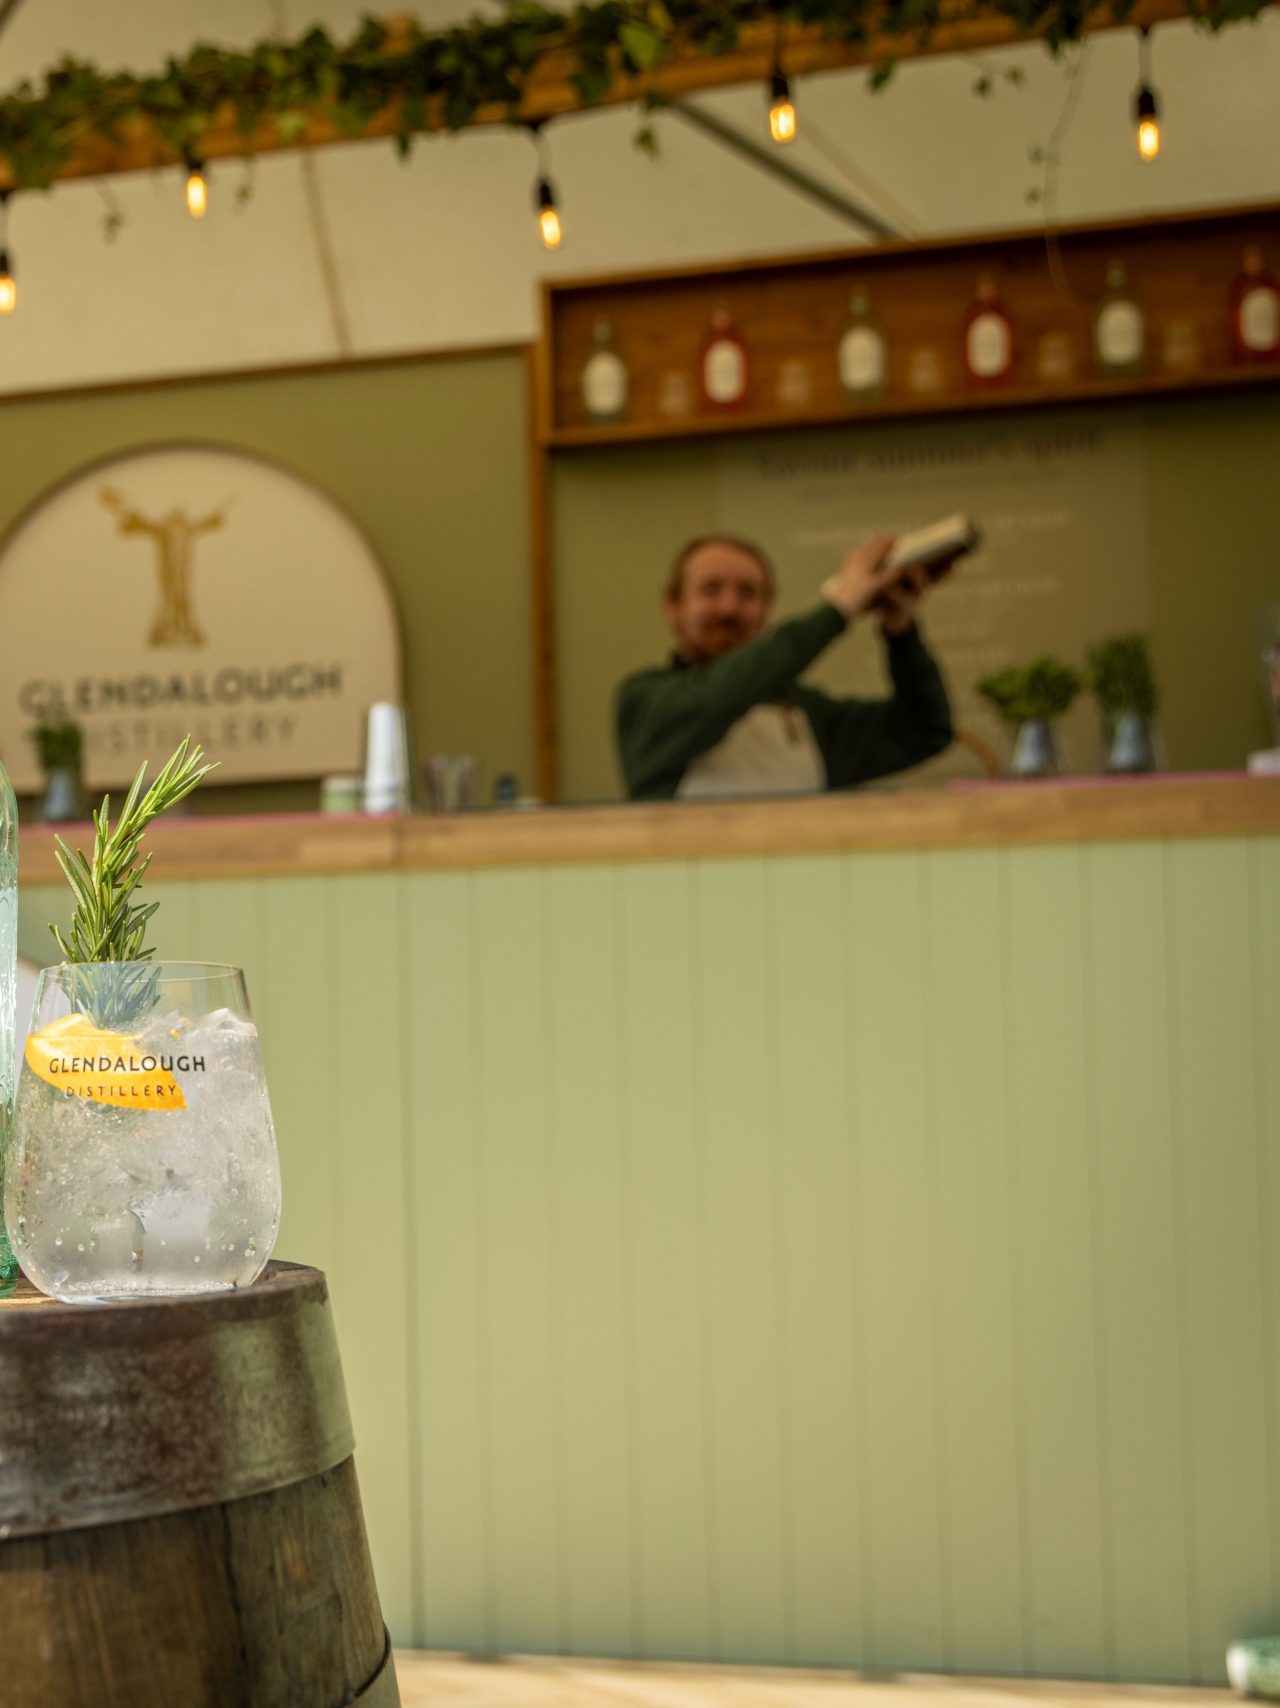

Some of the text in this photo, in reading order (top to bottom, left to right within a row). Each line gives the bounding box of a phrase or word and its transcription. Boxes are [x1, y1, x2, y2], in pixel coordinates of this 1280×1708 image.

[18, 662, 344, 716] GLENDALOUGH
[80, 714, 302, 755] ISTILLERY
[49, 1055, 206, 1074] GLENDALOUGH
[66, 1084, 177, 1097] DISTILLERY
